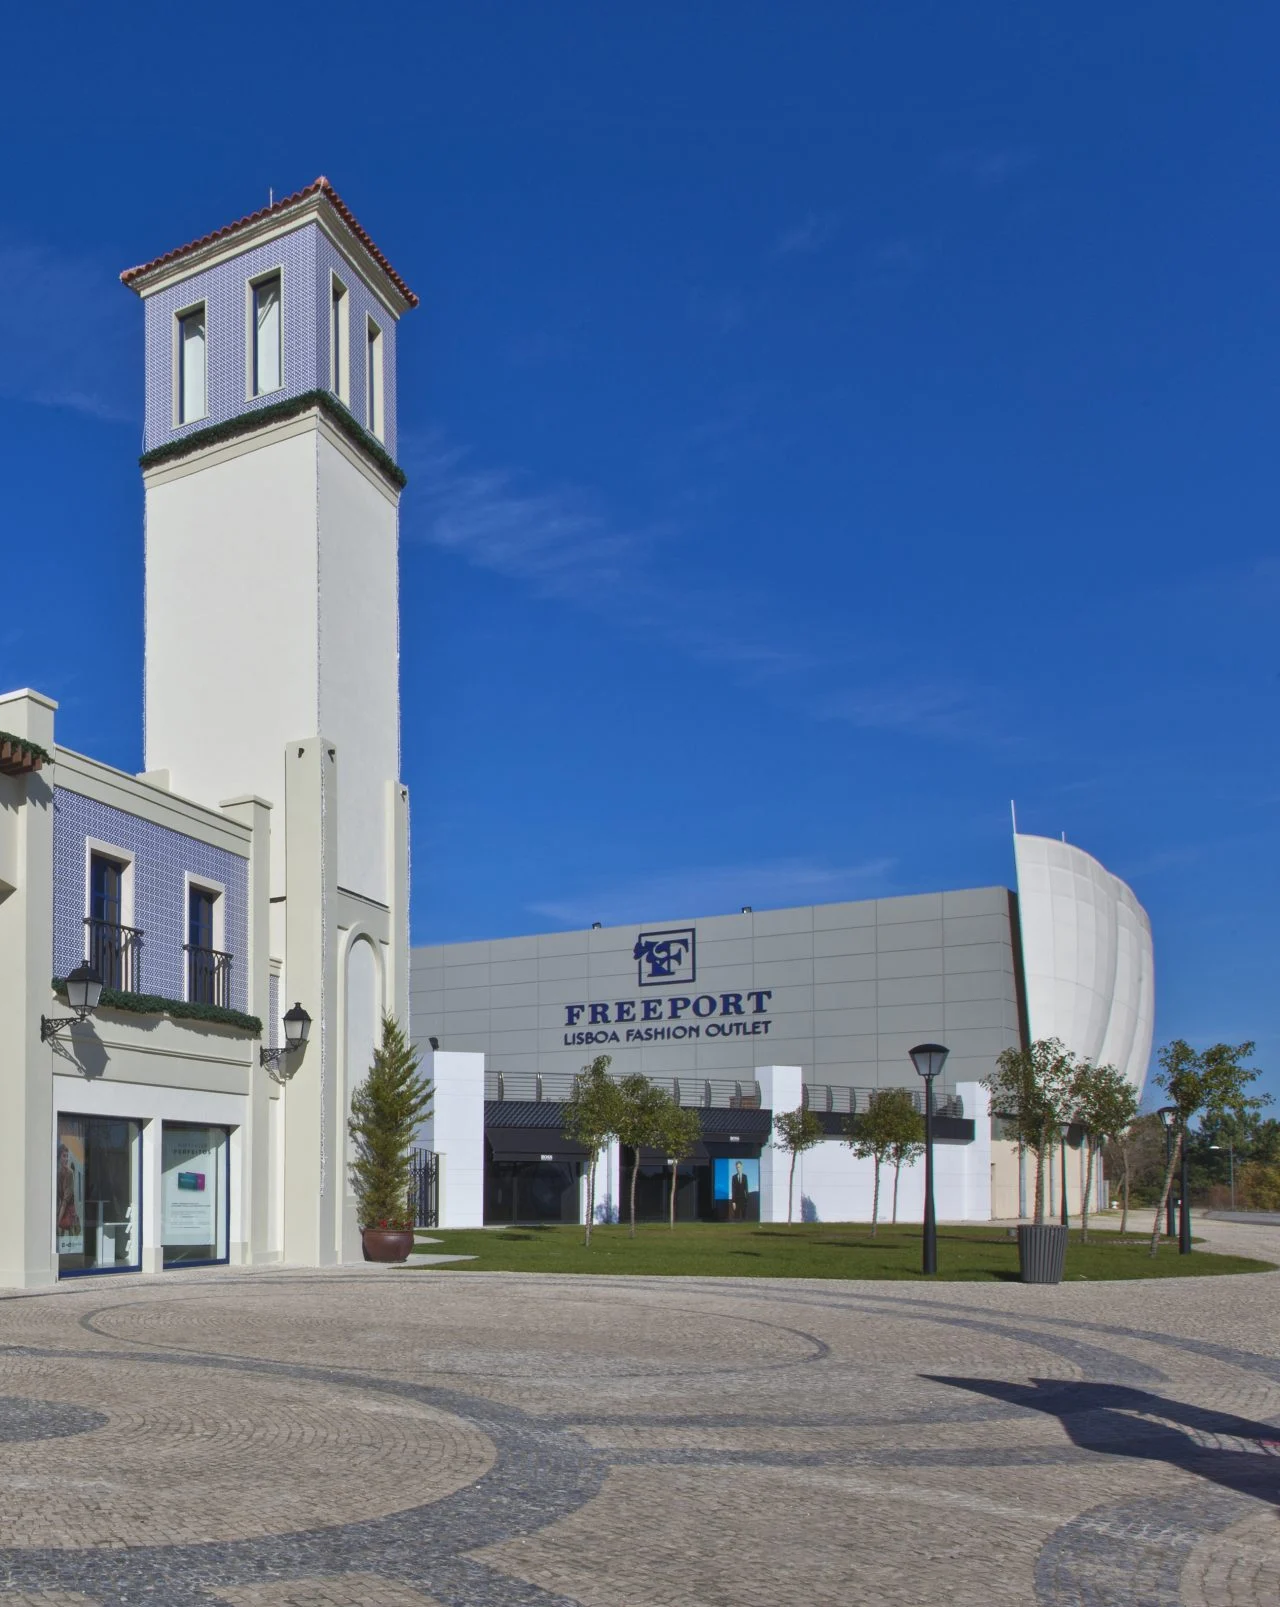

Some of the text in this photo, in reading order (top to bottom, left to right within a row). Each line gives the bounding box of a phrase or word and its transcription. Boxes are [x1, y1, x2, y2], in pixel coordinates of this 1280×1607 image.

[564, 990, 773, 1027] FREEPORT
[564, 1020, 772, 1046] LISBOA FASHION OUTLET
